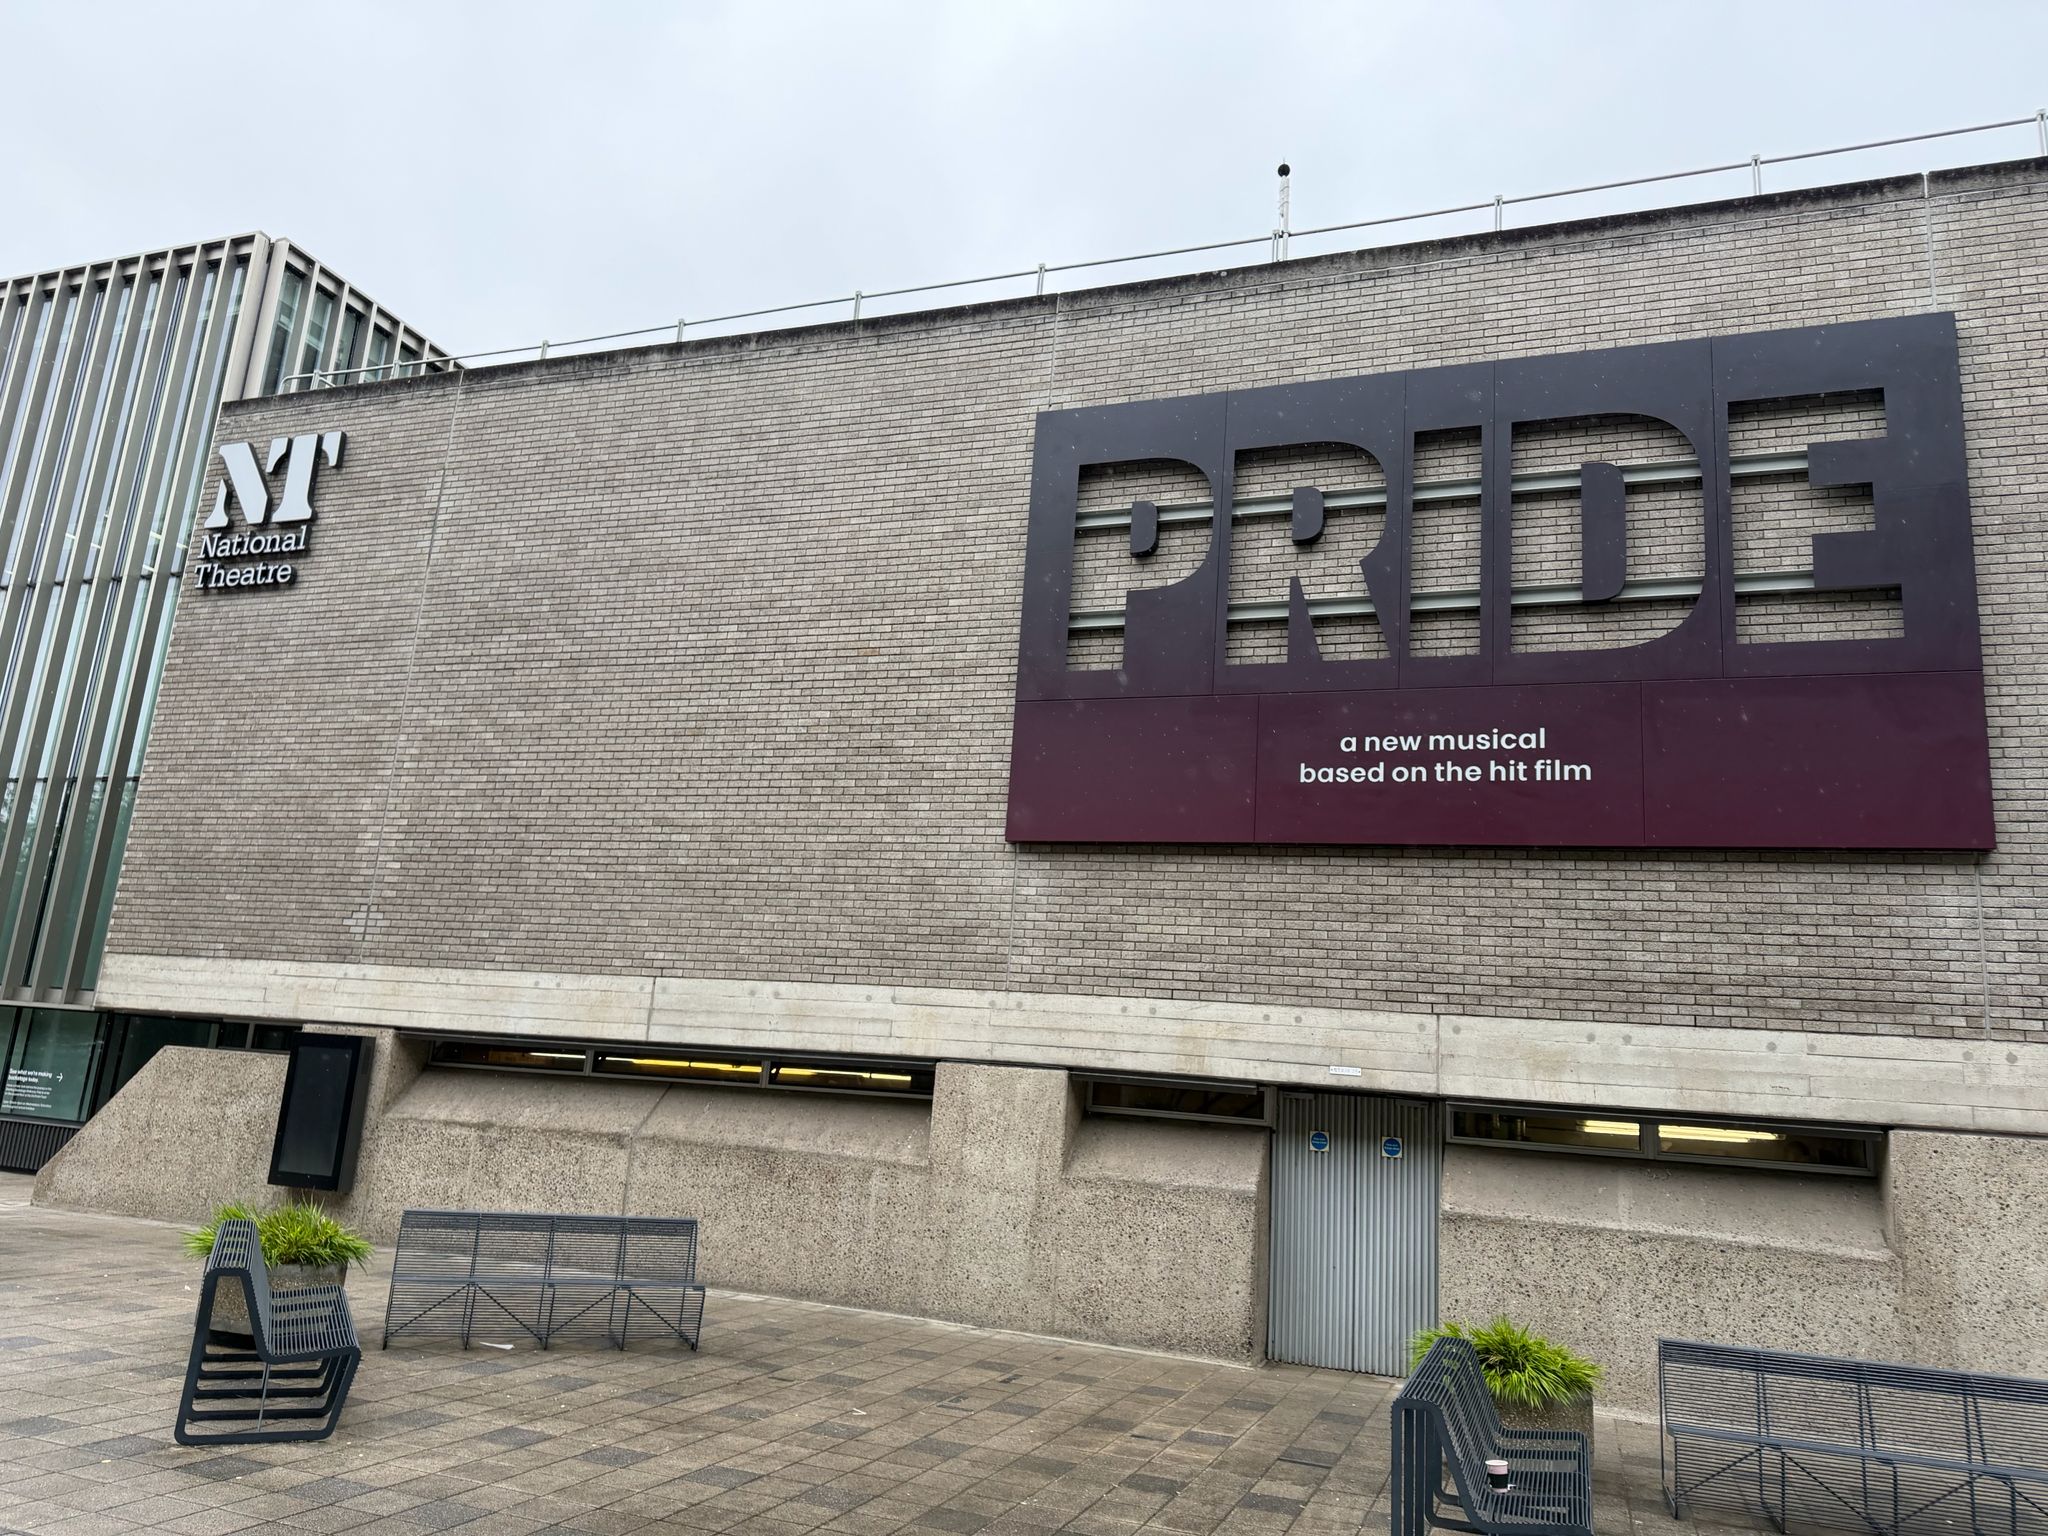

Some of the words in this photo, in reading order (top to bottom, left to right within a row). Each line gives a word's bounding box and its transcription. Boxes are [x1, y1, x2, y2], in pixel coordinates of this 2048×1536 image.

[204, 430, 344, 528] NT
[197, 525, 307, 559] National
[1065, 387, 1906, 672] PRIDE
[195, 563, 292, 588] Theatre
[1340, 736, 1356, 752] a
[1364, 735, 1421, 751] new
[1429, 727, 1546, 750] musical
[1299, 762, 1384, 783] based
[1392, 767, 1427, 782] on
[1435, 761, 1482, 782] the
[1490, 760, 1526, 781] hit
[1534, 759, 1592, 781] film
